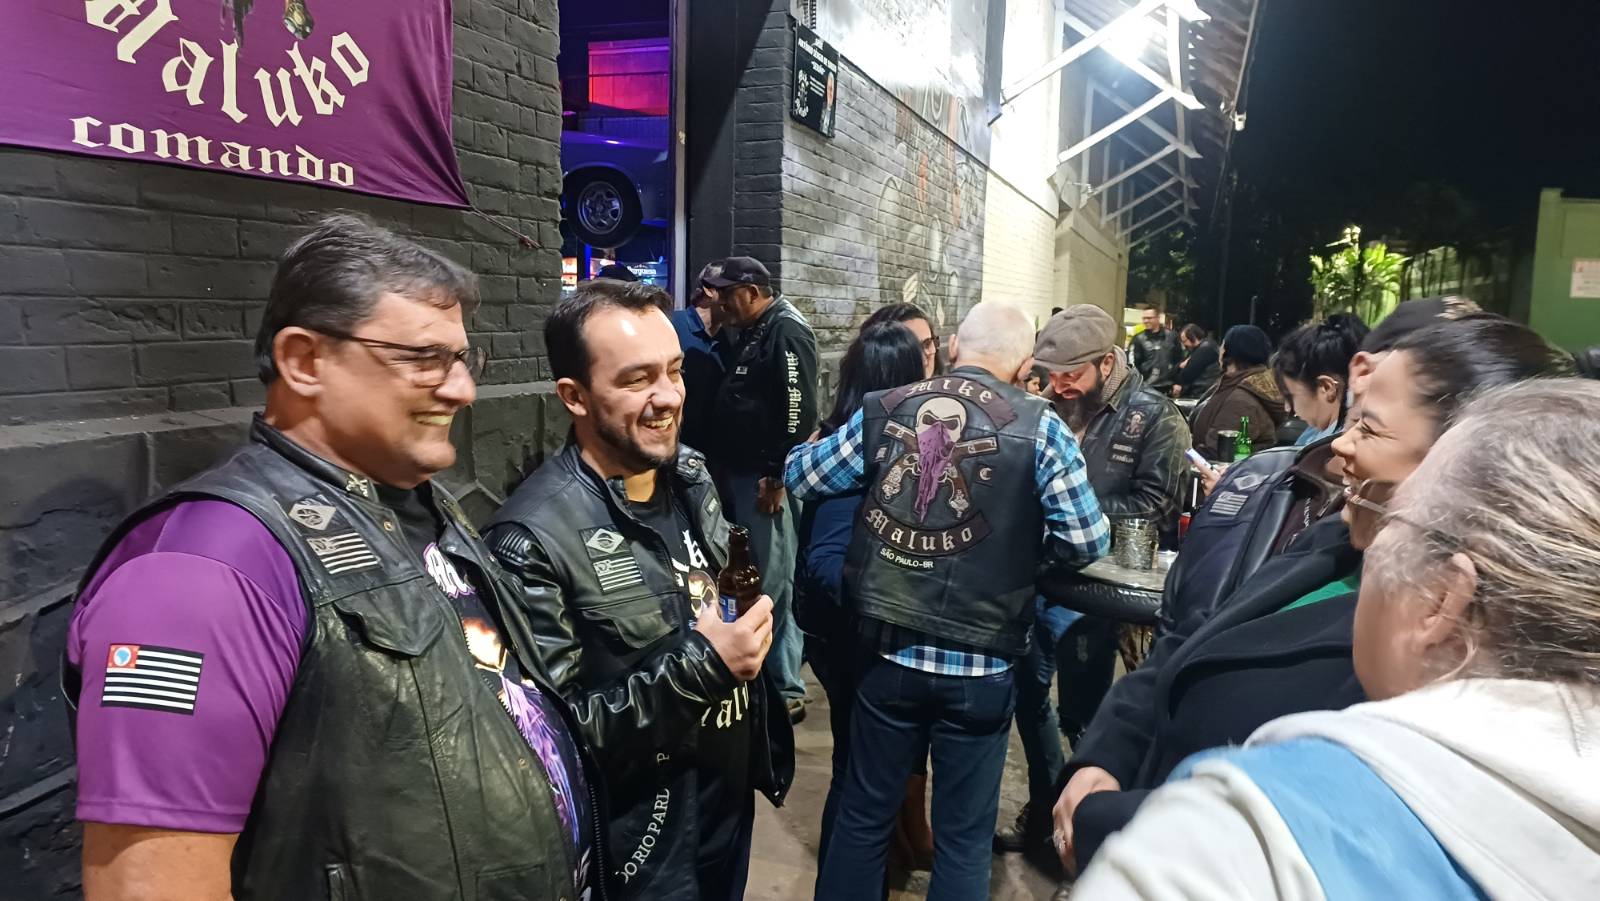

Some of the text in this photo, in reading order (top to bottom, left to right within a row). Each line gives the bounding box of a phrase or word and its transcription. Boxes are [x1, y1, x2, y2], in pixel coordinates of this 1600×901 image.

[69, 116, 354, 187] comando
[785, 350, 802, 434] Mike Maluko
[904, 379, 993, 403] Mike
[866, 508, 974, 551] Maluko
[632, 835, 656, 864] RIO
